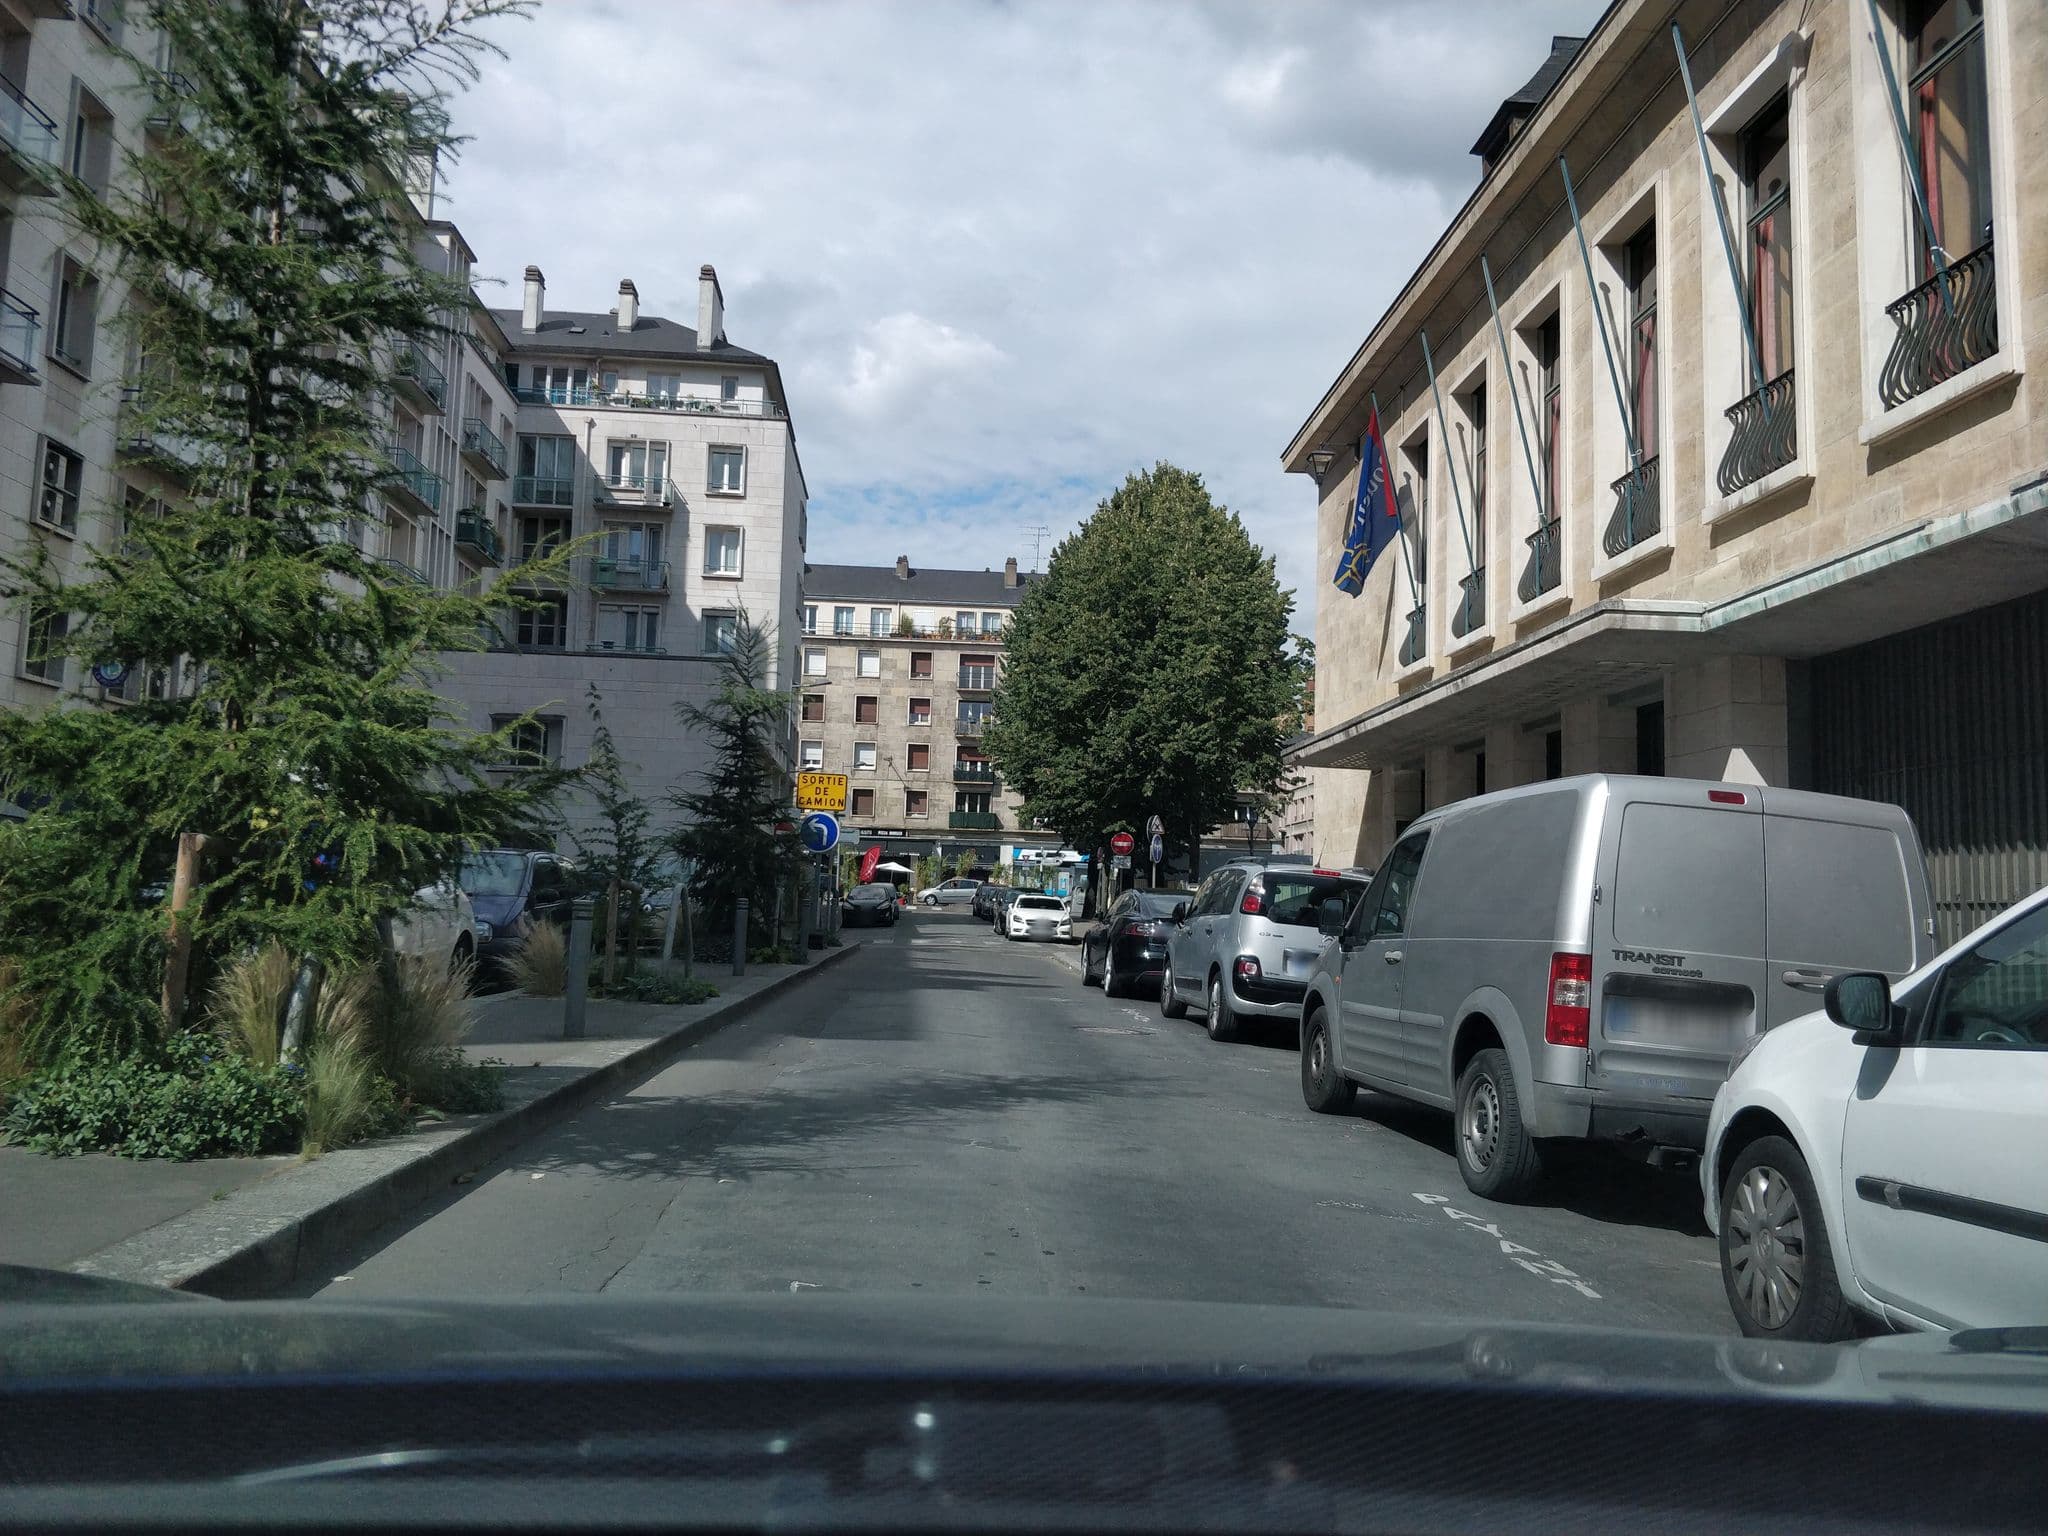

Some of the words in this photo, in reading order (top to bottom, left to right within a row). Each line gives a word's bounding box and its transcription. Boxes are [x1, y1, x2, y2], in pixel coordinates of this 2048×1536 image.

[802, 775, 844, 786] SORTIE
[815, 786, 829, 796] DE
[798, 796, 845, 807] CAMION
[1611, 949, 1686, 967] TRANSIT
[1652, 966, 1703, 978] connect
[1411, 1192, 1603, 1299] PAYANT
